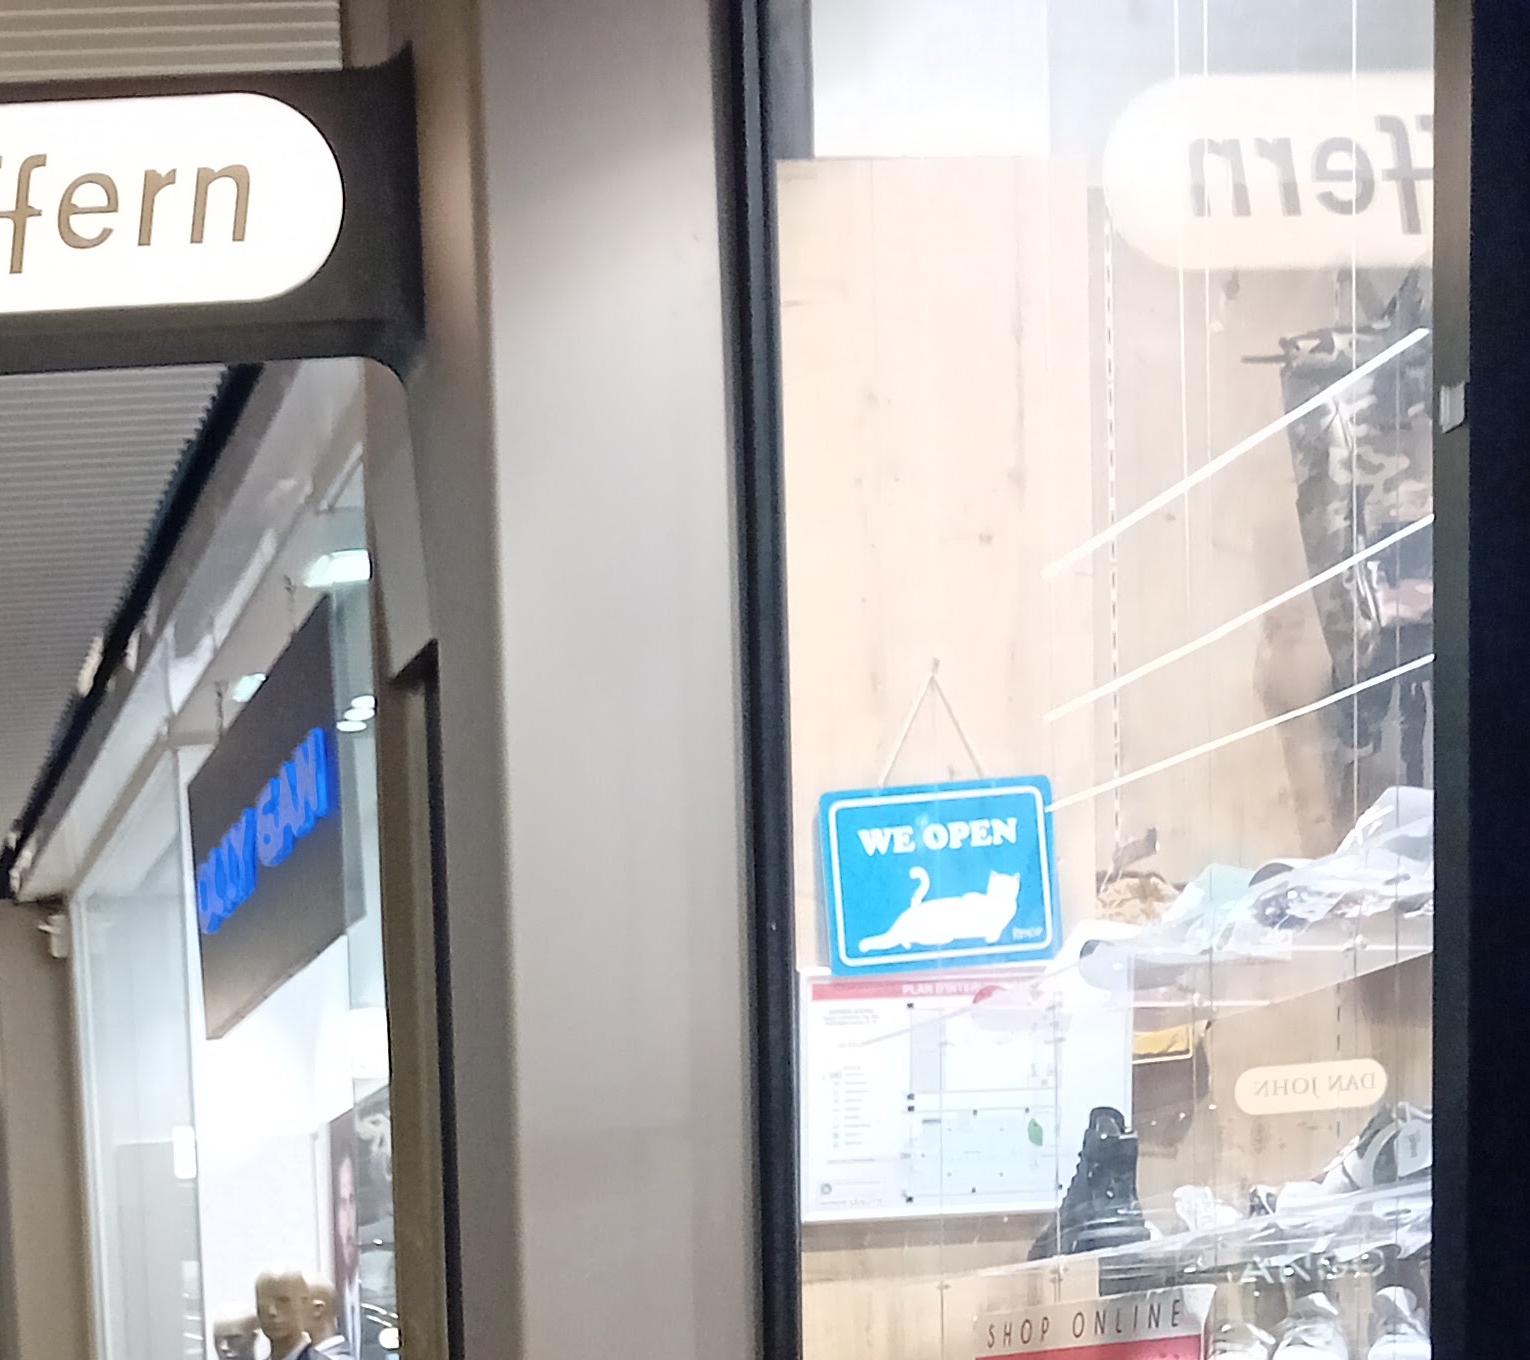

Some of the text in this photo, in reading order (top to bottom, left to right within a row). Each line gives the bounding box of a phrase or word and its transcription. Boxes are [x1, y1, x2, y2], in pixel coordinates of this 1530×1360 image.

[857, 817, 1018, 857] WE OPEN
[986, 1299, 1181, 1348] SHOP ONLINE
